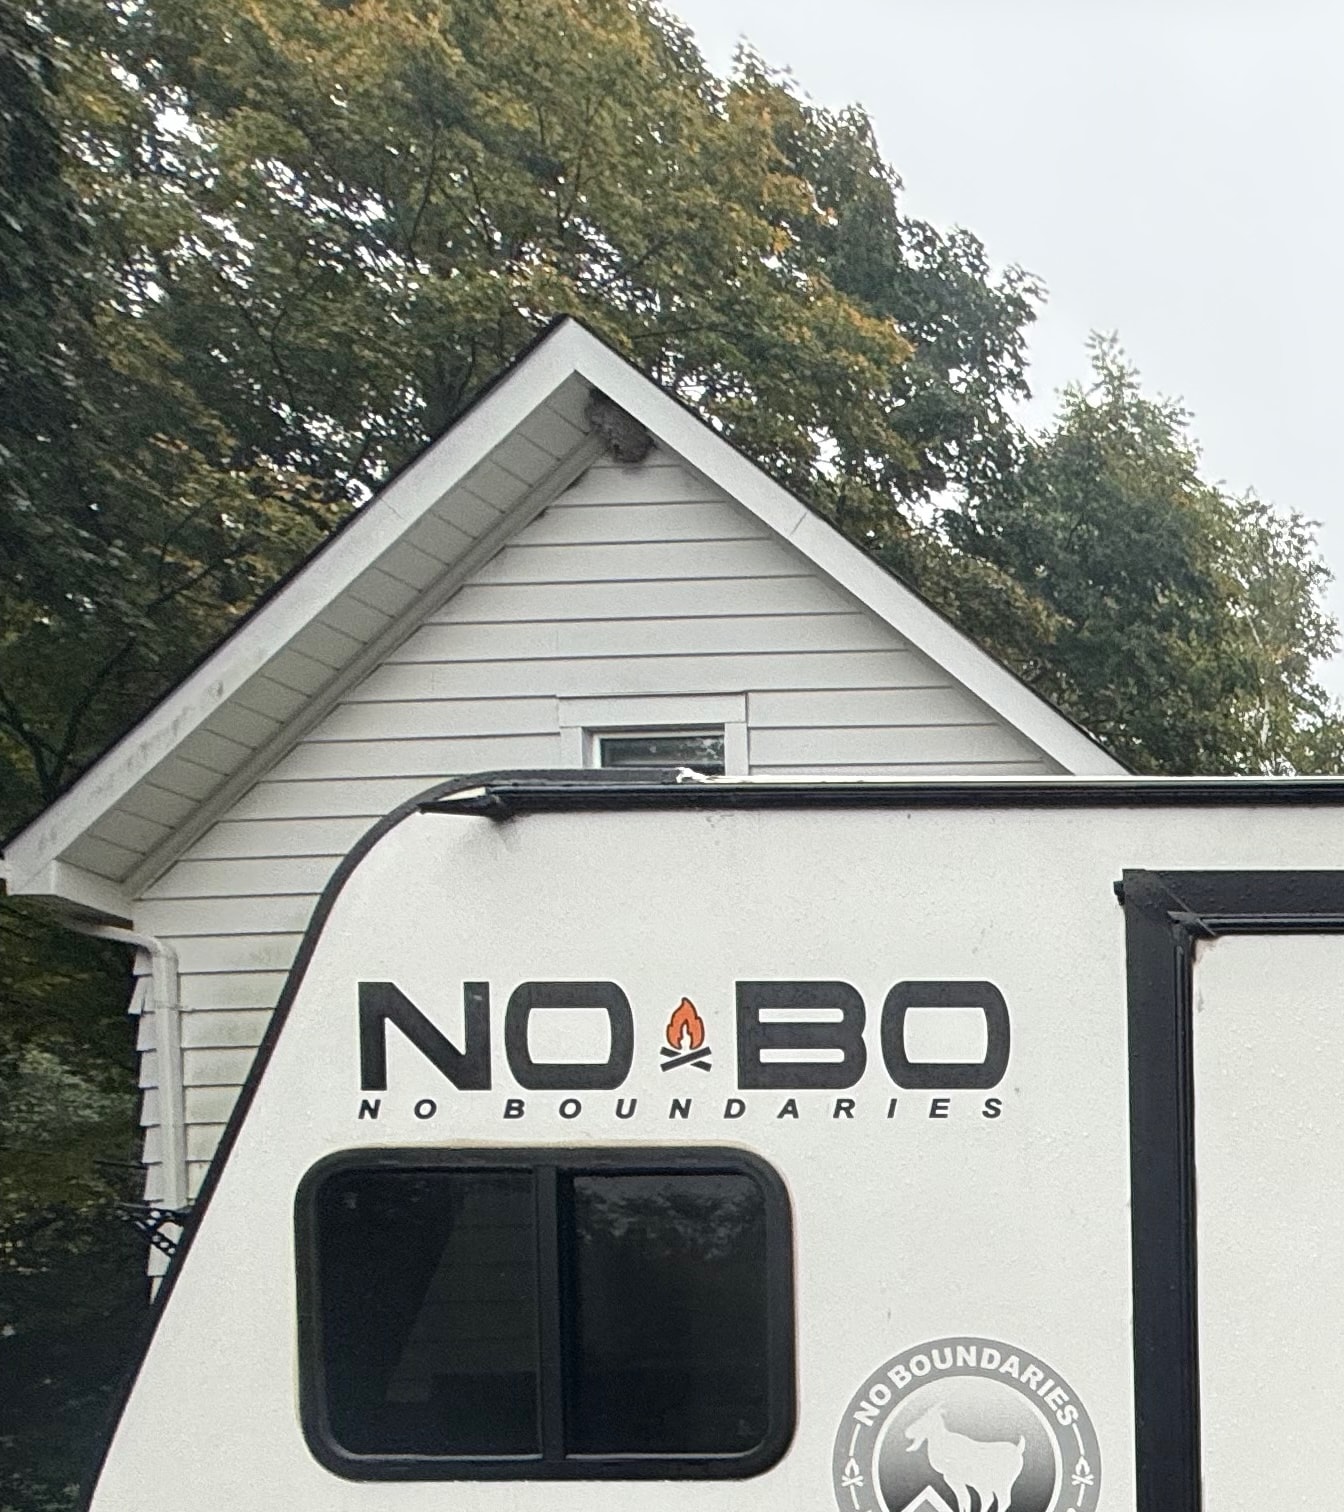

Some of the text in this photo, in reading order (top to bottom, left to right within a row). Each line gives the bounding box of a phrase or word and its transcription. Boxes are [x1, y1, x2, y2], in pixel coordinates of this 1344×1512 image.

[358, 981, 1011, 1091] NO BO
[358, 1098, 1003, 1120] NO BOUNDARIES
[853, 1345, 1079, 1427] NO BOUNDARIES
